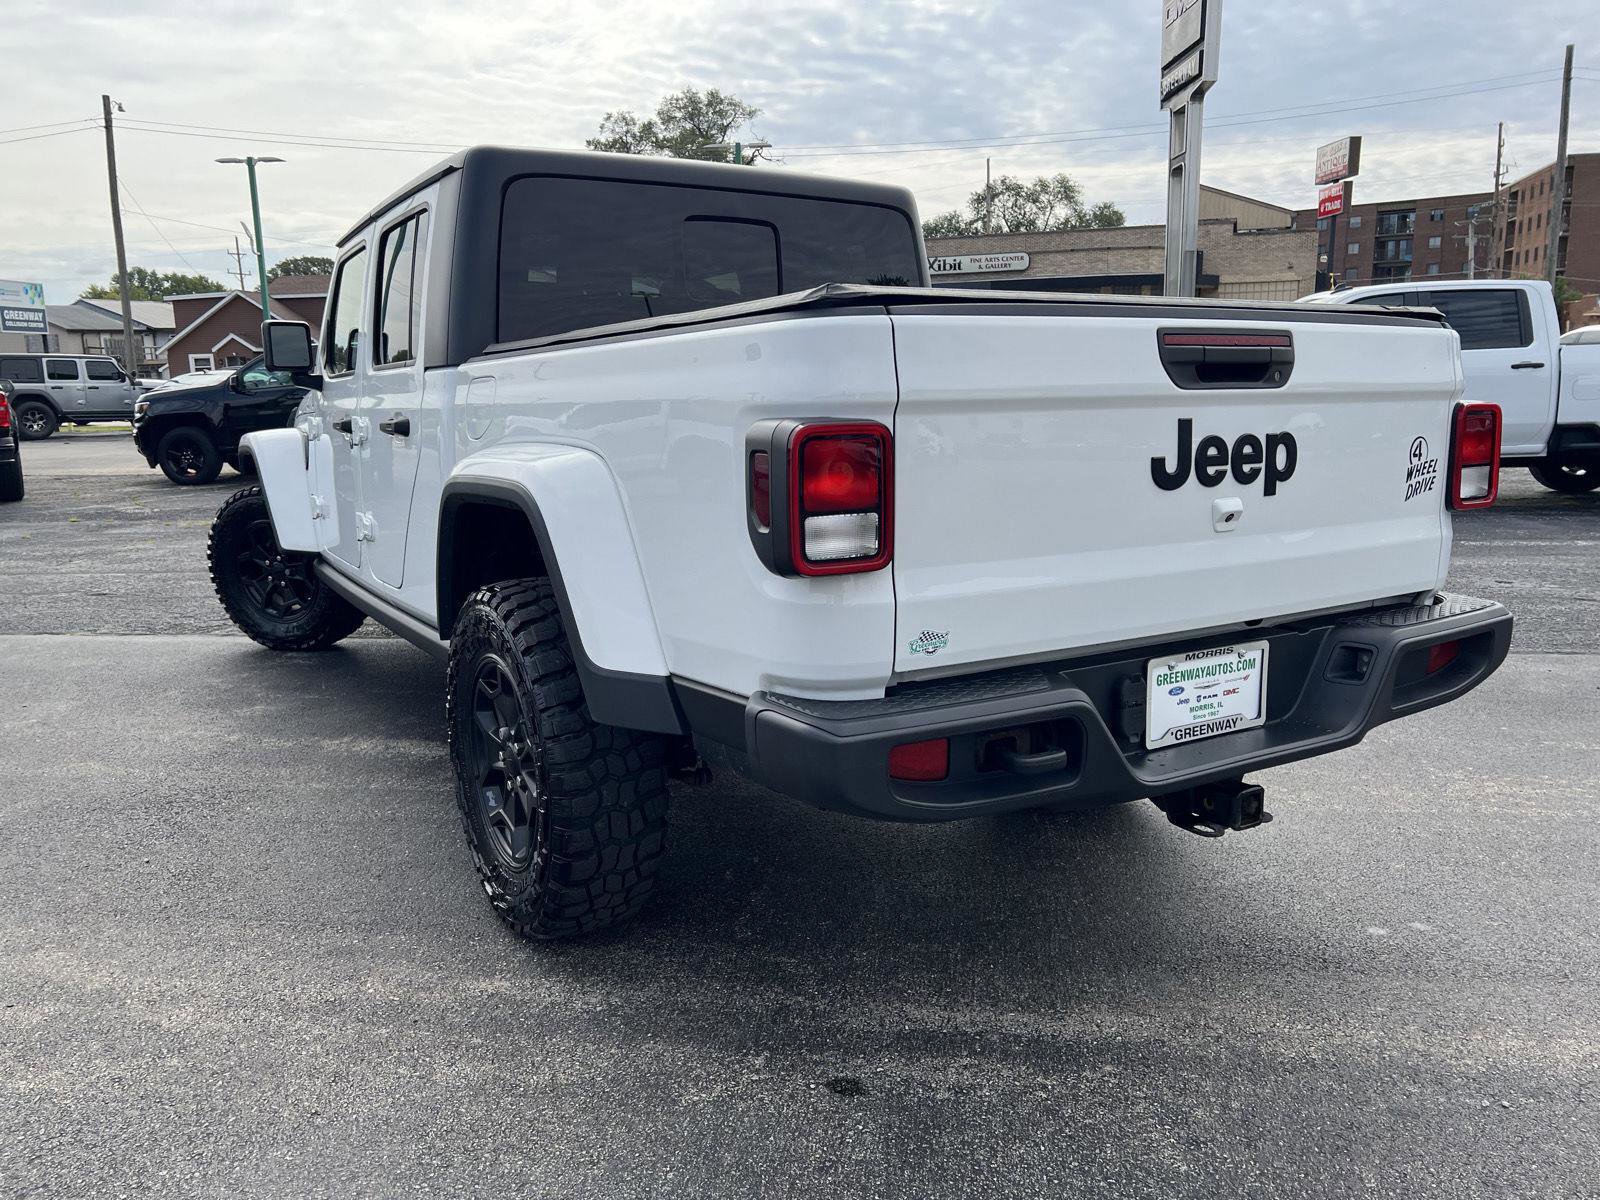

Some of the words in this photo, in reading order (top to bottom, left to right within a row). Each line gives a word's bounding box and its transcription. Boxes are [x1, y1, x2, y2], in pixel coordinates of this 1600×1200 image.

[1317, 153, 1347, 172] ANTIQUE
[4, 310, 43, 321] GREENWAY
[1151, 418, 1298, 497] Jeep
[1406, 458, 1438, 484] WHEEL
[1405, 475, 1437, 502] DRIVE
[1185, 646, 1234, 661] MORRIS
[1156, 658, 1256, 686] GREENWAYAUTOS.COM
[1223, 687, 1240, 696] GMC
[1177, 698, 1190, 706] Jeep
[1189, 702, 1216, 713] MORRIS,
[1174, 717, 1239, 741] GREENWAY
